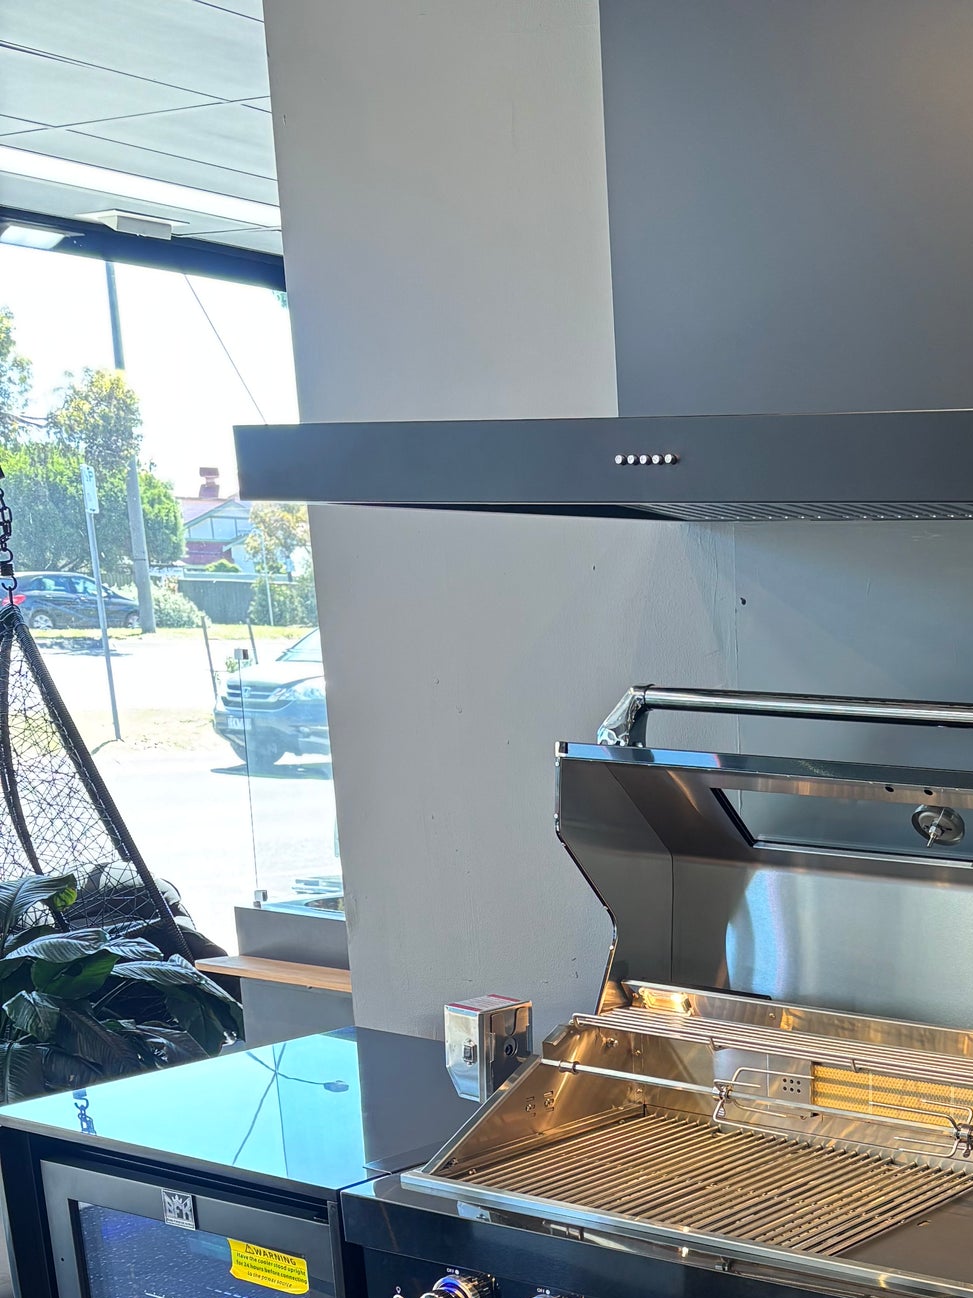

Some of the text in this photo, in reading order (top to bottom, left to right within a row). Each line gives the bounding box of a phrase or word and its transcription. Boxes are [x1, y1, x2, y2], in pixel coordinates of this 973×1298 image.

[236, 1252, 249, 1260] Have
[258, 1258, 273, 1266] cooler
[288, 1267, 306, 1277] upright
[253, 1247, 296, 1266] WARNING
[250, 1263, 264, 1272] hours
[264, 1267, 280, 1276] before
[281, 1272, 307, 1285] connecting
[261, 1275, 276, 1283] power
